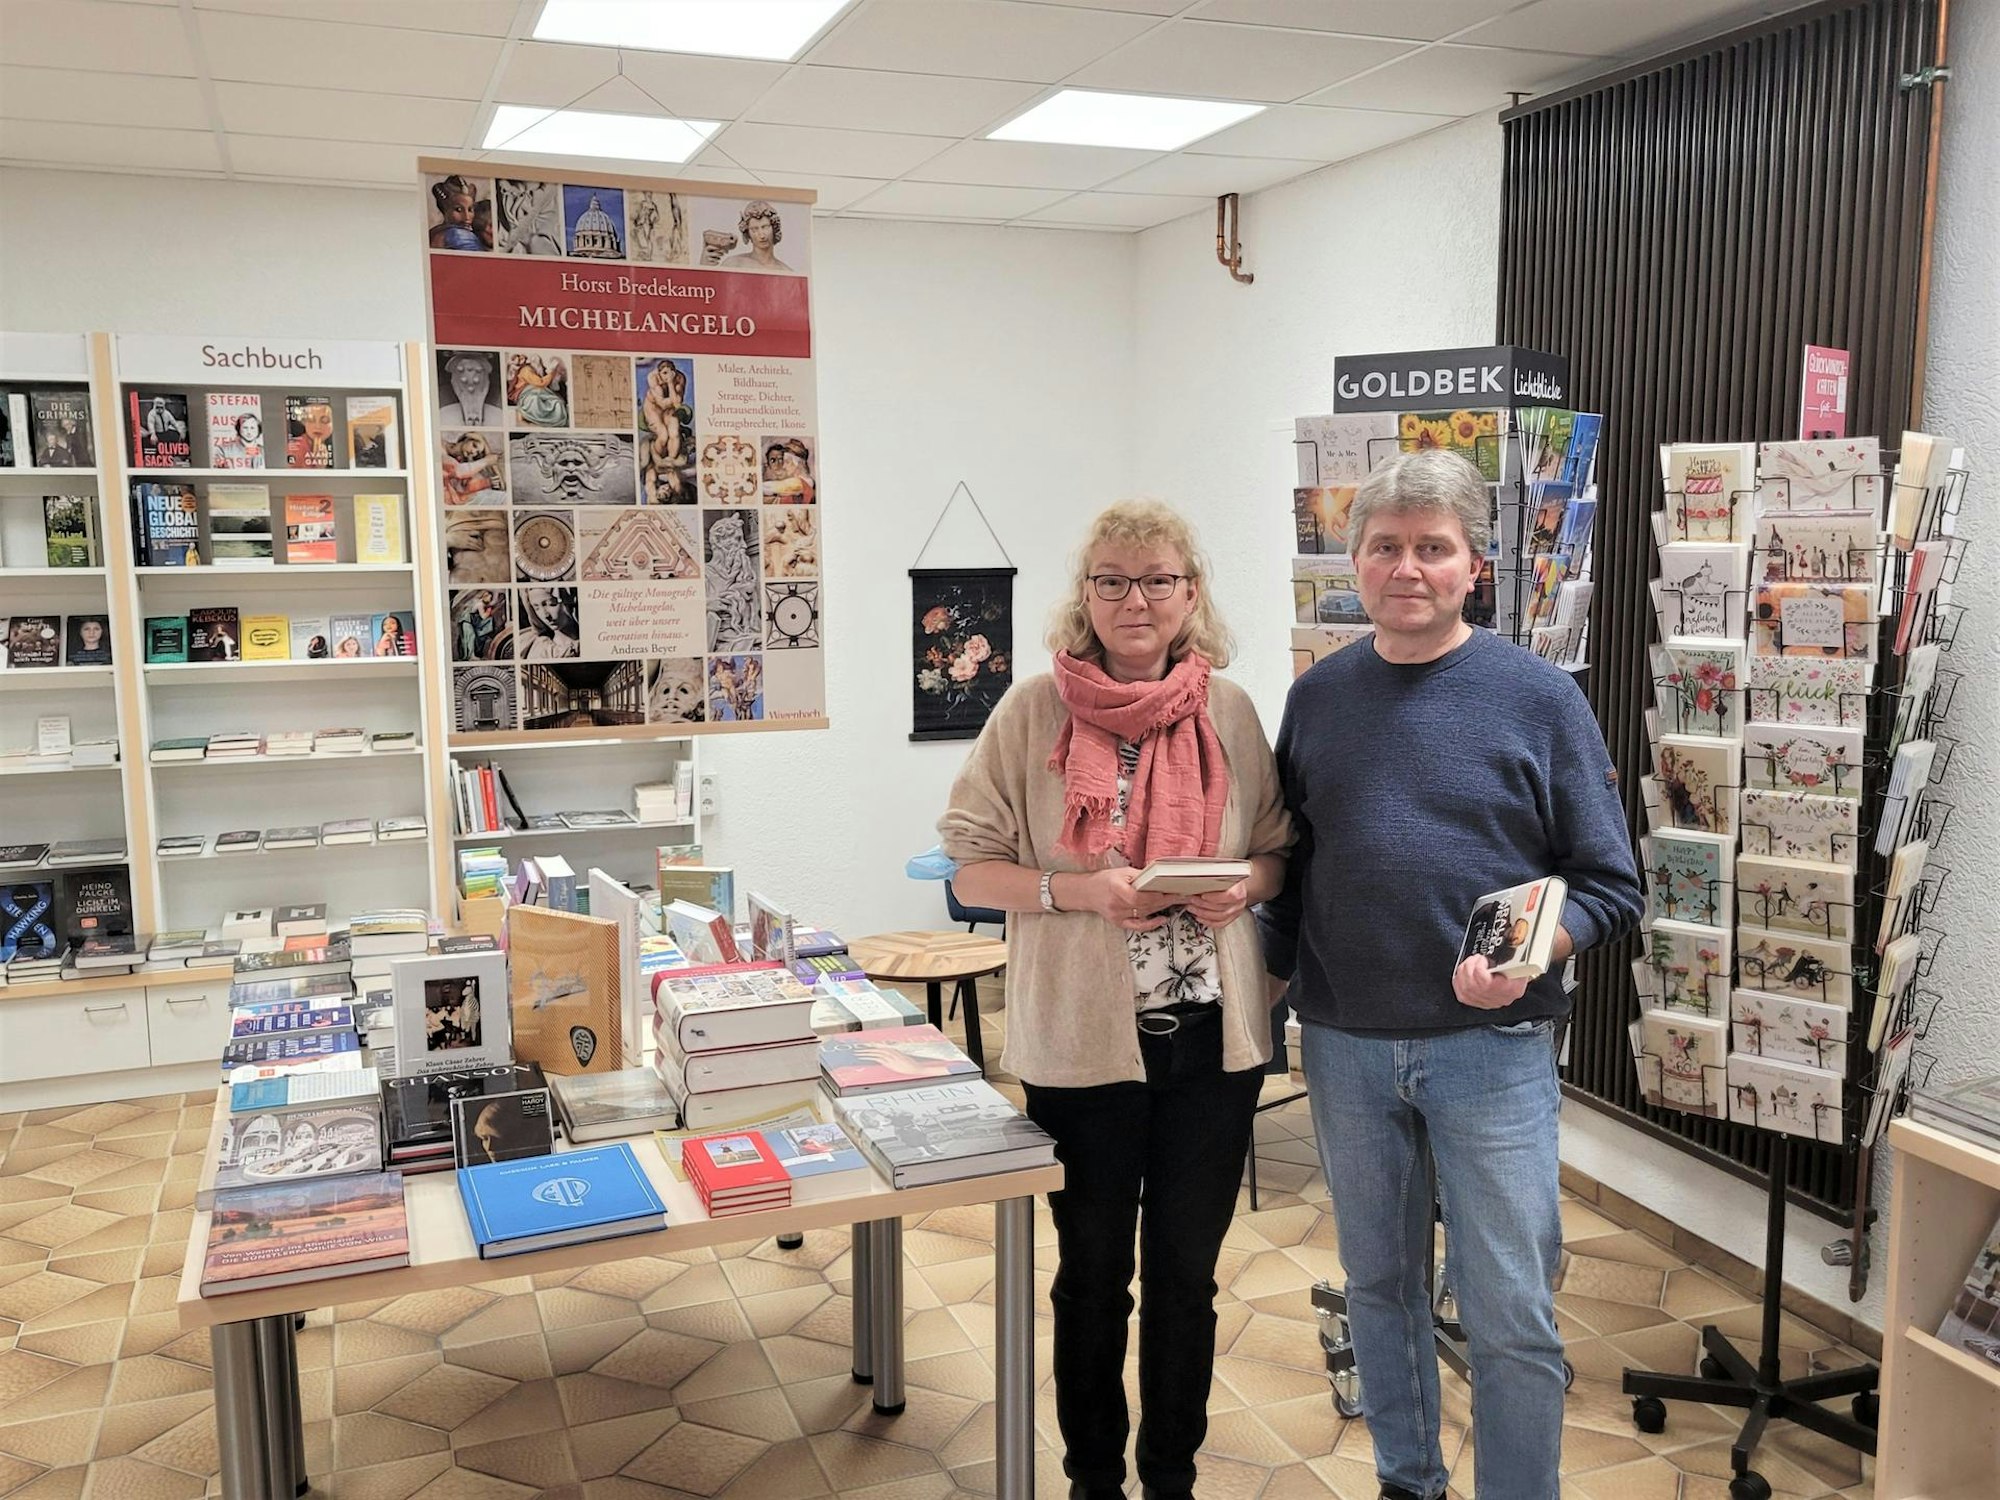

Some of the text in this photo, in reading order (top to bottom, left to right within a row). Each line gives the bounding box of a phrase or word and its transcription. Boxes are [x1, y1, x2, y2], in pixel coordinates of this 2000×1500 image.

[561, 272, 716, 304] Horst Bredekamp
[518, 305, 756, 337] MICHELANGELO
[202, 345, 322, 369] Sachbuch
[718, 363, 793, 375] Maler, Architekt,
[733, 377, 778, 388] Bildhauer,
[1337, 366, 1504, 399] GOLDBEK
[1514, 368, 1562, 400] Lichtblicke
[1816, 379, 1837, 397] KARTEN
[210, 395, 259, 406] STEFAN
[717, 390, 795, 404] Stratege, Dichter,
[51, 403, 71, 411] DIE
[711, 403, 801, 416] Jahrtausendkünstler,
[37, 410, 85, 420] GRIMMS
[707, 417, 806, 430] Vertragsbrecher, Ikone
[158, 443, 189, 454] OLIVER
[145, 455, 174, 467] SACKS
[147, 495, 182, 511] NEUE
[612, 587, 643, 600] gültige
[645, 586, 697, 600] Monografie
[609, 601, 676, 615] Michelangelos,
[606, 616, 680, 627] weit über unsere
[597, 631, 648, 642] Generation
[611, 643, 677, 655] Andreas Beyer
[82, 882, 112, 891] HEINO
[79, 889, 115, 897] FALCKE
[77, 899, 104, 907] LICHT
[76, 905, 121, 914] DUNKELN
[8, 900, 48, 940] HAWKING
[425, 1060, 444, 1068] Klaus
[464, 1056, 486, 1064] Zehrer
[1676, 1061, 1692, 1073] 60
[432, 1064, 474, 1073] schreckliche
[388, 1064, 531, 1088] CHANSON
[866, 1086, 975, 1107] RHEIN
[242, 1244, 337, 1263] KÜNSTLERFAMILIE
[338, 1238, 363, 1248] VON
[364, 1234, 396, 1243] WILLE
[245, 1247, 285, 1256] Weimar
[304, 1236, 355, 1248] Rheinland
